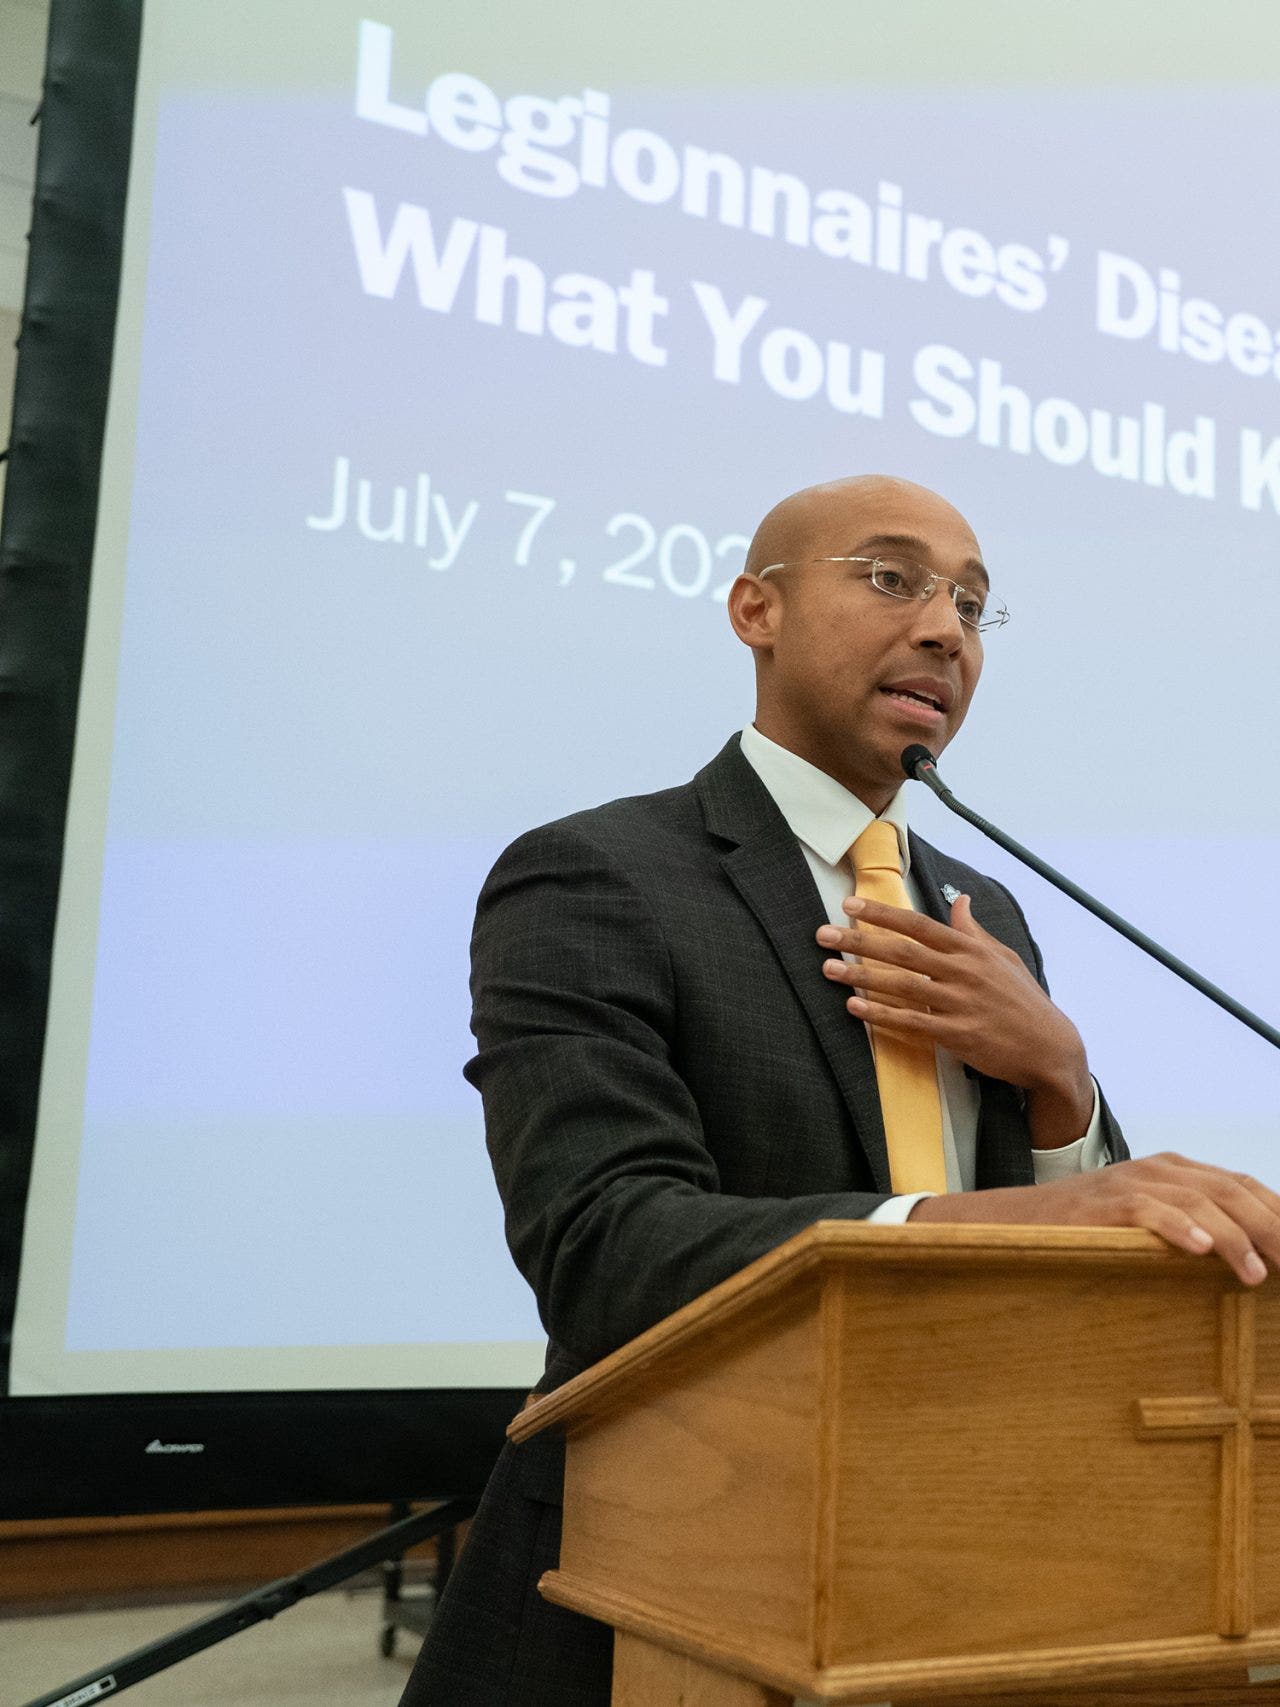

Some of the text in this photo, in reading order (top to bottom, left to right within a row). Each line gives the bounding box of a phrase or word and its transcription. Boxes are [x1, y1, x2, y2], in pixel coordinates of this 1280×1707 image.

[355, 18, 1069, 313] Legionnaires’
[342, 187, 669, 367] What
[690, 280, 884, 421] You
[908, 343, 1216, 499] Should
[305, 456, 753, 603] July 7, 202
